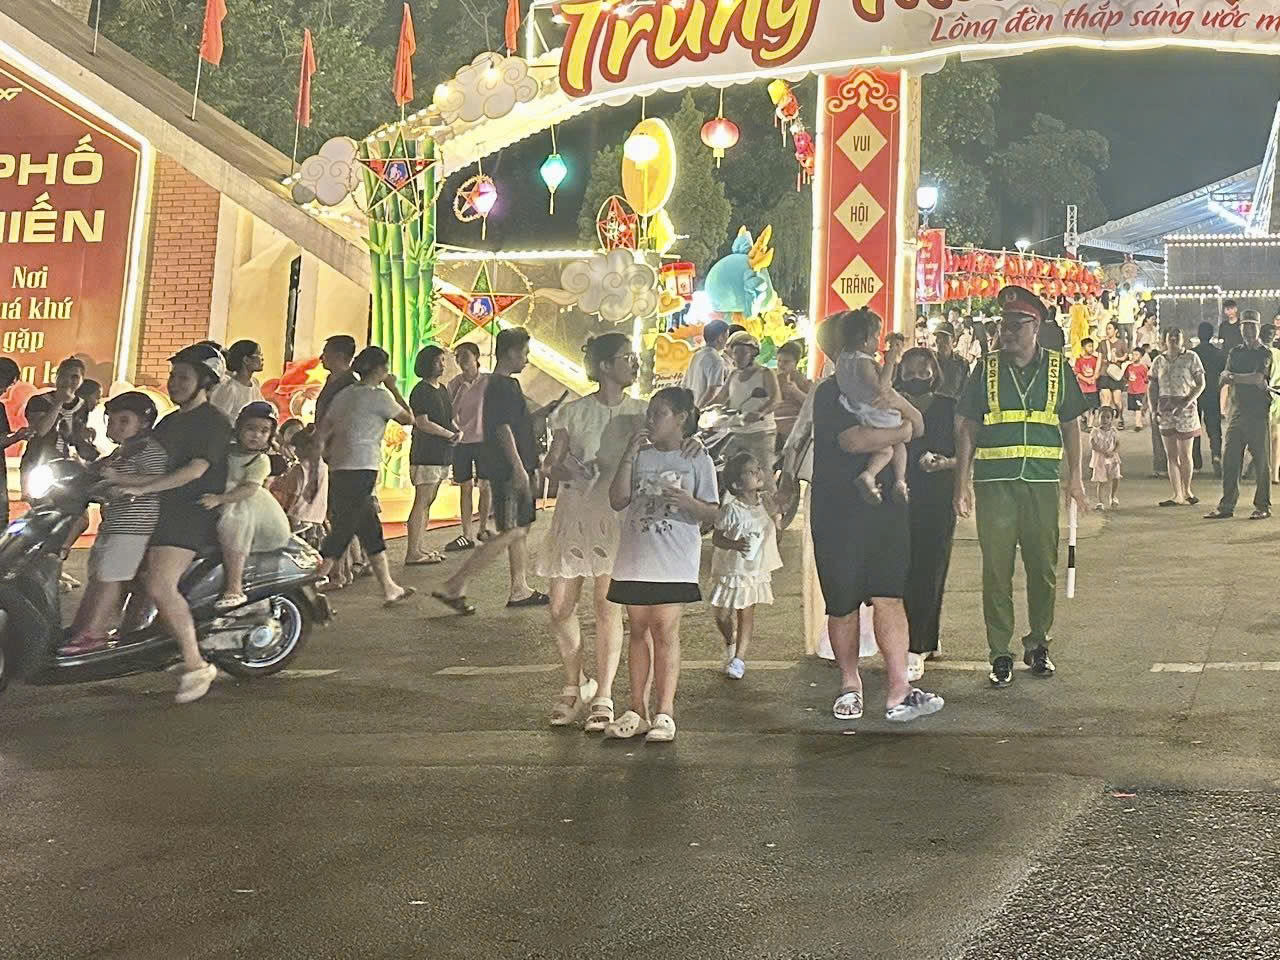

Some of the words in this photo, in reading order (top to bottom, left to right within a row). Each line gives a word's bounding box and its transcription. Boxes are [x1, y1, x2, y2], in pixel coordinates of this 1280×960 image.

[930, 12, 998, 42] Lồng
[1005, 6, 1054, 33] đèn
[1063, 2, 1124, 34] thắp
[1129, 2, 1195, 34] sáng
[1201, 3, 1250, 28] ước
[853, 135, 870, 152] VUI
[0, 191, 105, 243] IẾN
[850, 201, 869, 226] HỘI
[12, 265, 49, 289] Nơi
[840, 274, 874, 294] TRĂNG
[28, 296, 74, 320] khứ
[2, 327, 45, 354] gặp
